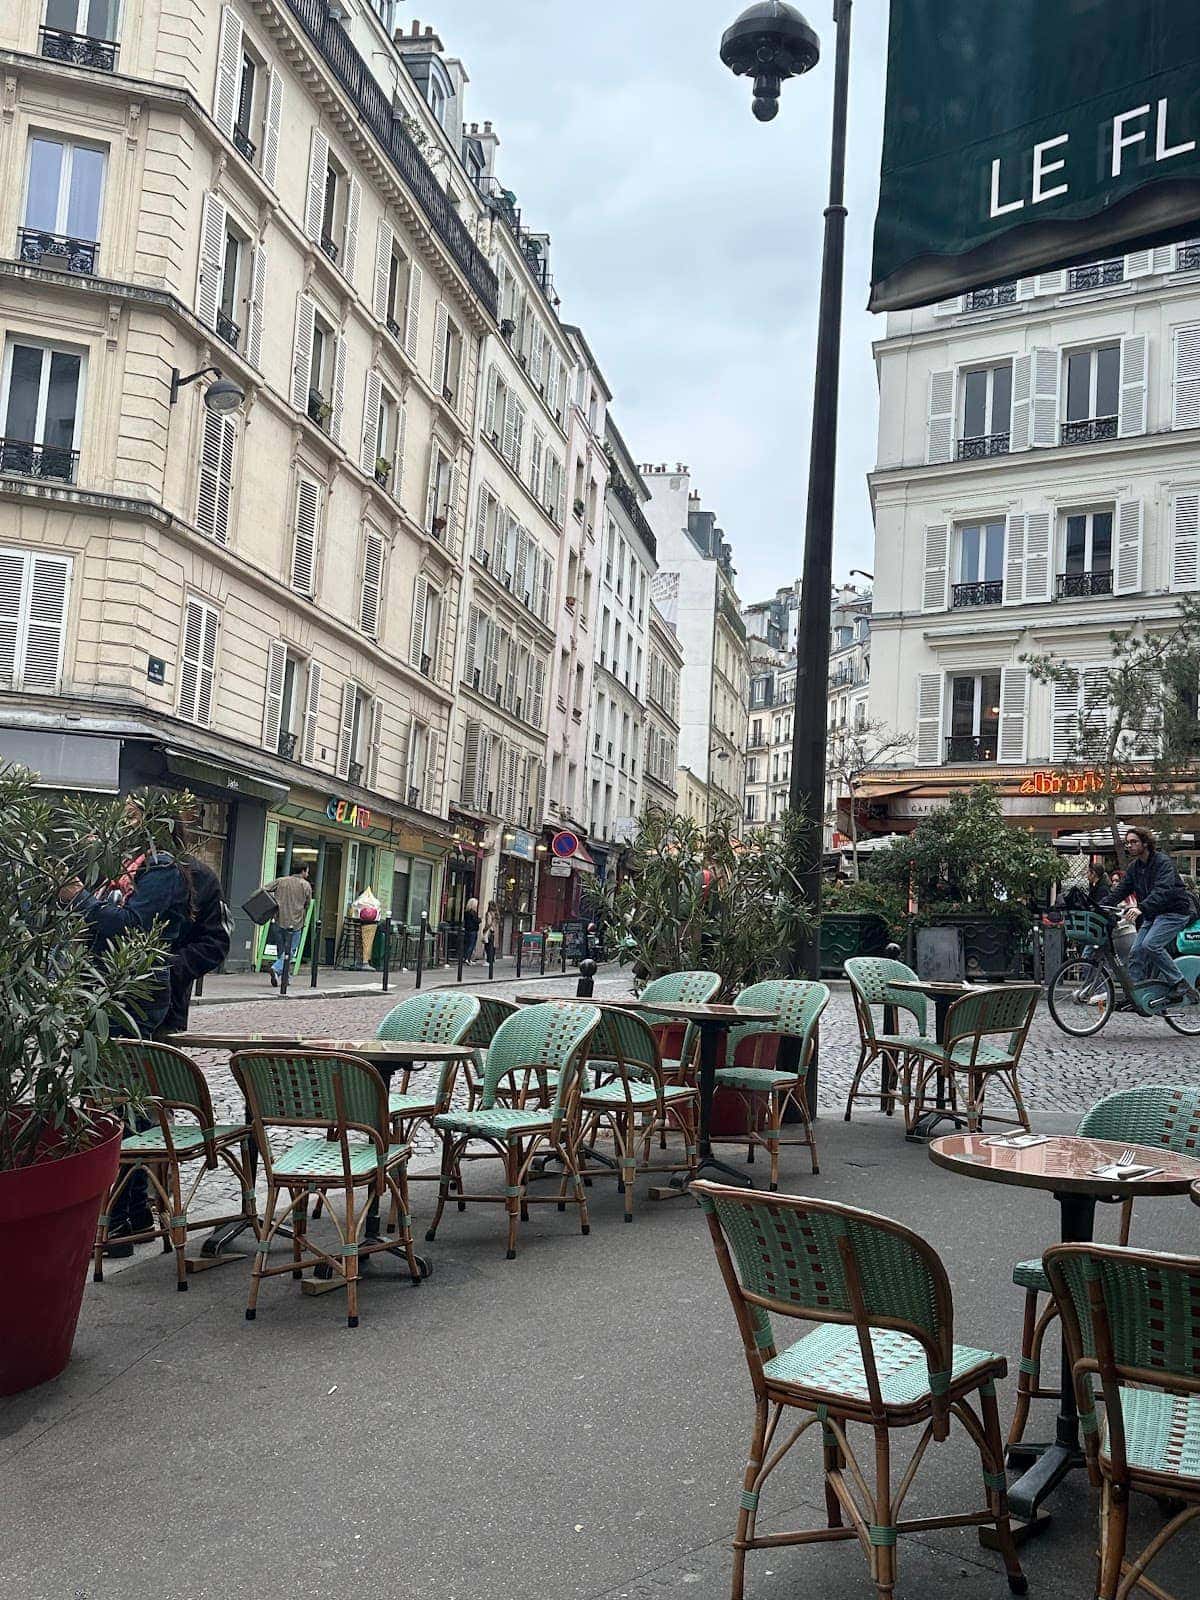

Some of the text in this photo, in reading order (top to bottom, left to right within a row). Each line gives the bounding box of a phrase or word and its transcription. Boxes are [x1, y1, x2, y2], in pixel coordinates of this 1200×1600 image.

[989, 97, 1196, 218] LE FL
[326, 796, 371, 829] GELATO
